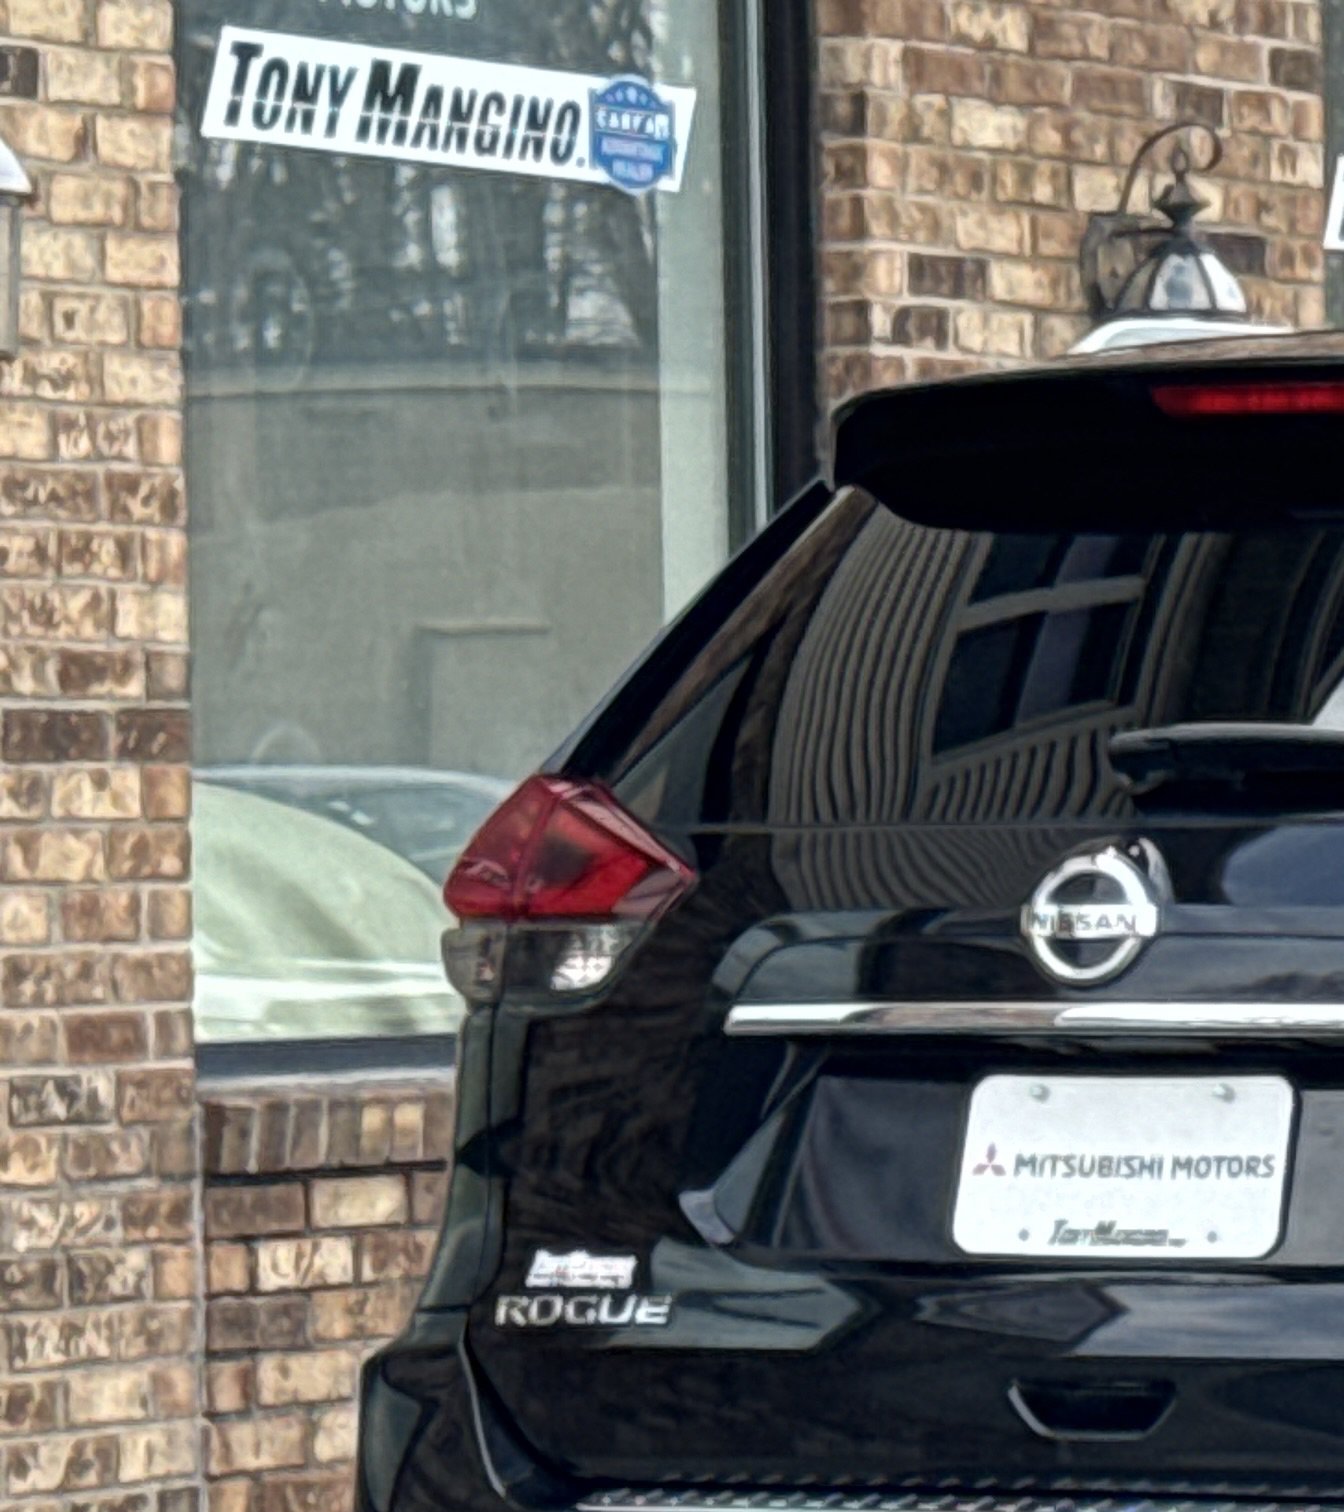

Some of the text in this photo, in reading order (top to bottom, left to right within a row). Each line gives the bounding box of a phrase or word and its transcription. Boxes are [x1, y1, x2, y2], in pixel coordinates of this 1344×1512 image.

[224, 41, 358, 138] TONY
[1031, 912, 1138, 932] NISSAN
[1013, 1153, 1276, 1180] MITSUBISHI MOTORS
[494, 1293, 673, 1327] ROGUE
